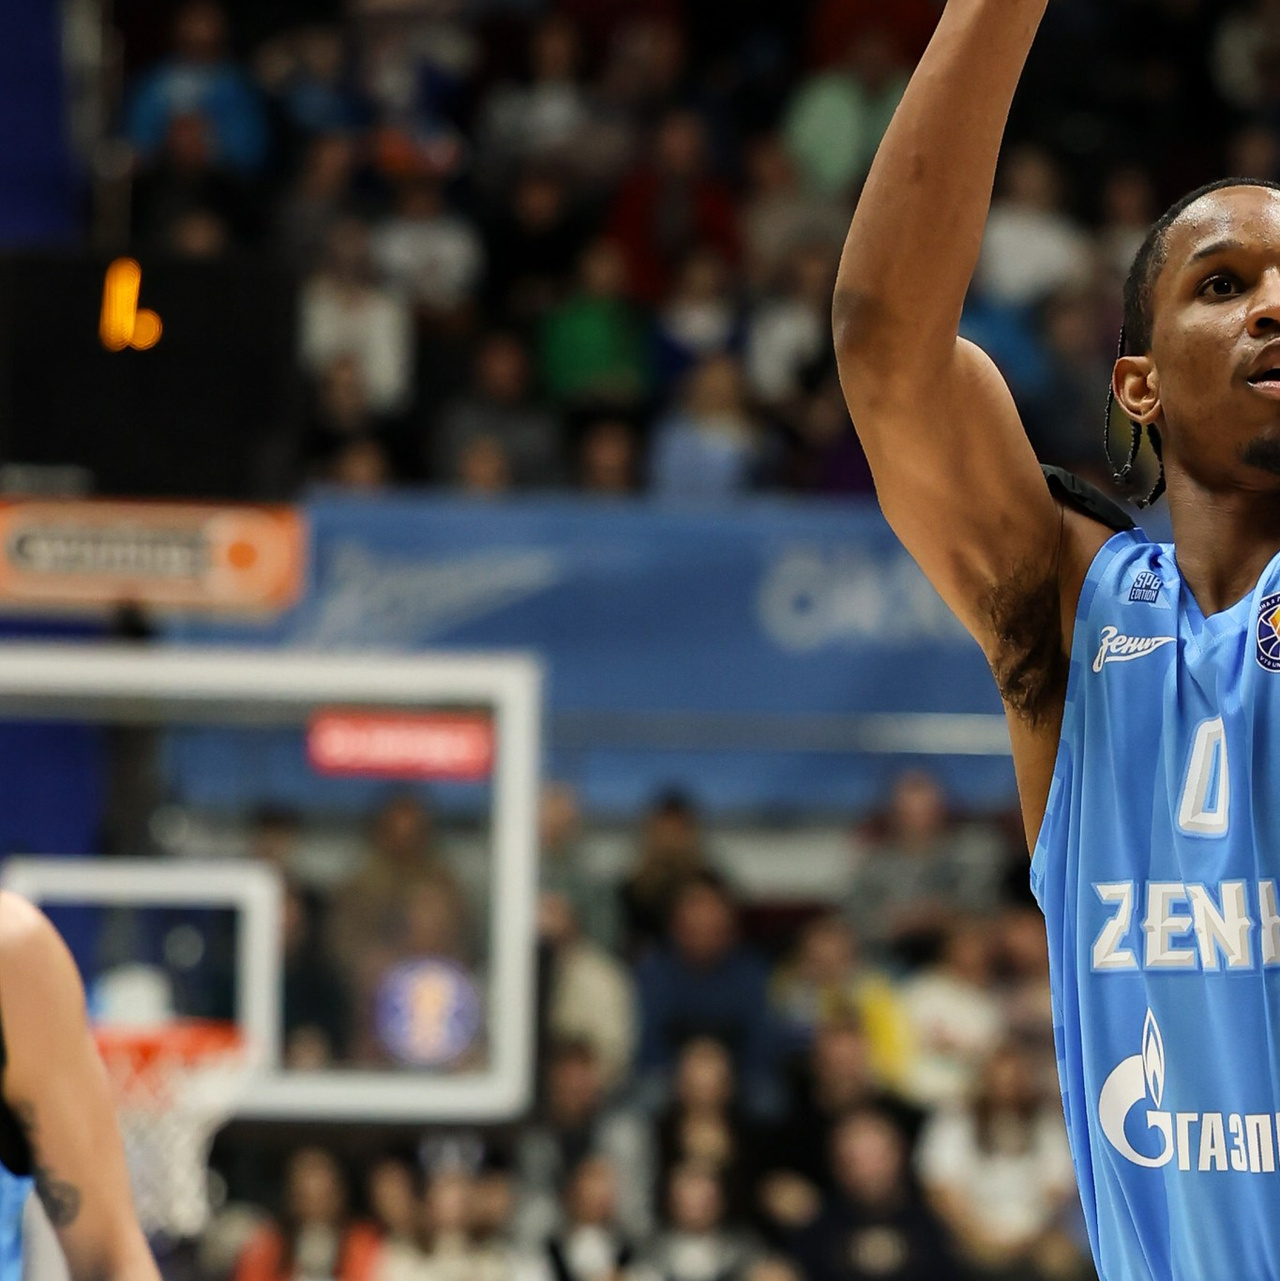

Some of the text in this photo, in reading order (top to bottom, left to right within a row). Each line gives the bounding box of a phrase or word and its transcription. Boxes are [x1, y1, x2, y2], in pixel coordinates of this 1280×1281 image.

[1130, 588, 1158, 601] EDITION
[1259, 655, 1271, 666] VTB
[1178, 716, 1230, 836] 0
